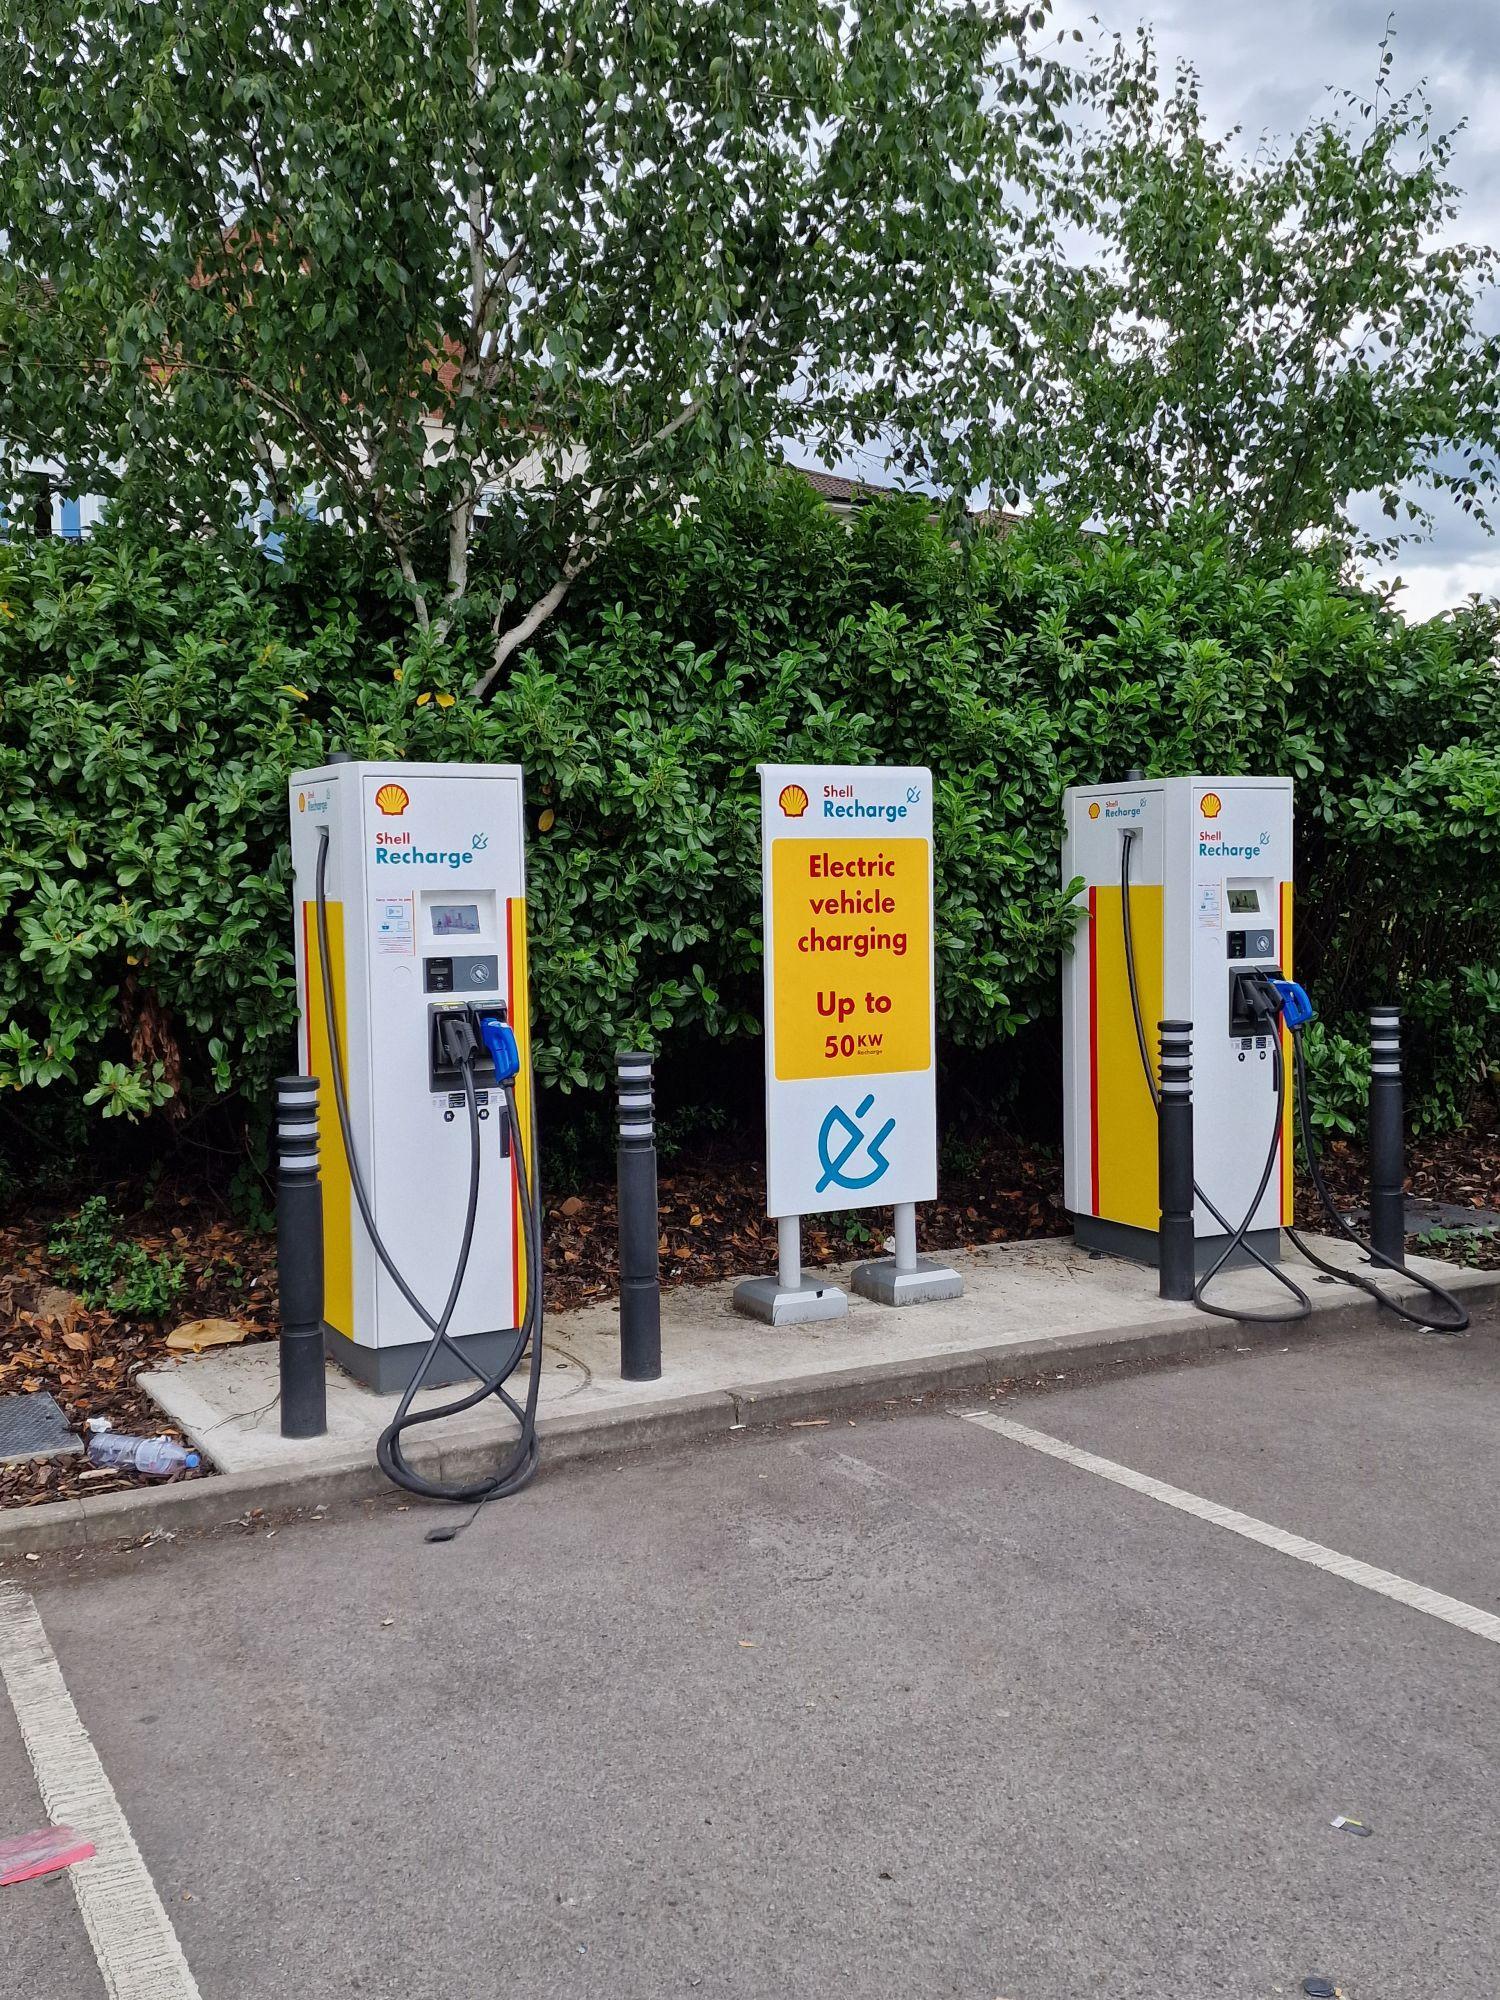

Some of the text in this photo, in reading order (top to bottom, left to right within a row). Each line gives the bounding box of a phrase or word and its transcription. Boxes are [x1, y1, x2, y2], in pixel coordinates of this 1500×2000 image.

[823, 785, 853, 797] Shell
[823, 799, 907, 822] Recharge
[1105, 807, 1141, 817] Recharge
[375, 832, 410, 845] Shell
[1199, 831, 1222, 841] Shell
[375, 846, 473, 868] Recharge
[1199, 842, 1260, 859] Recharge
[809, 853, 896, 878] Electric
[809, 889, 896, 914] vehicle
[797, 926, 907, 957] charging
[816, 991, 892, 1023] Up to
[824, 1034, 883, 1058] 50 KW
